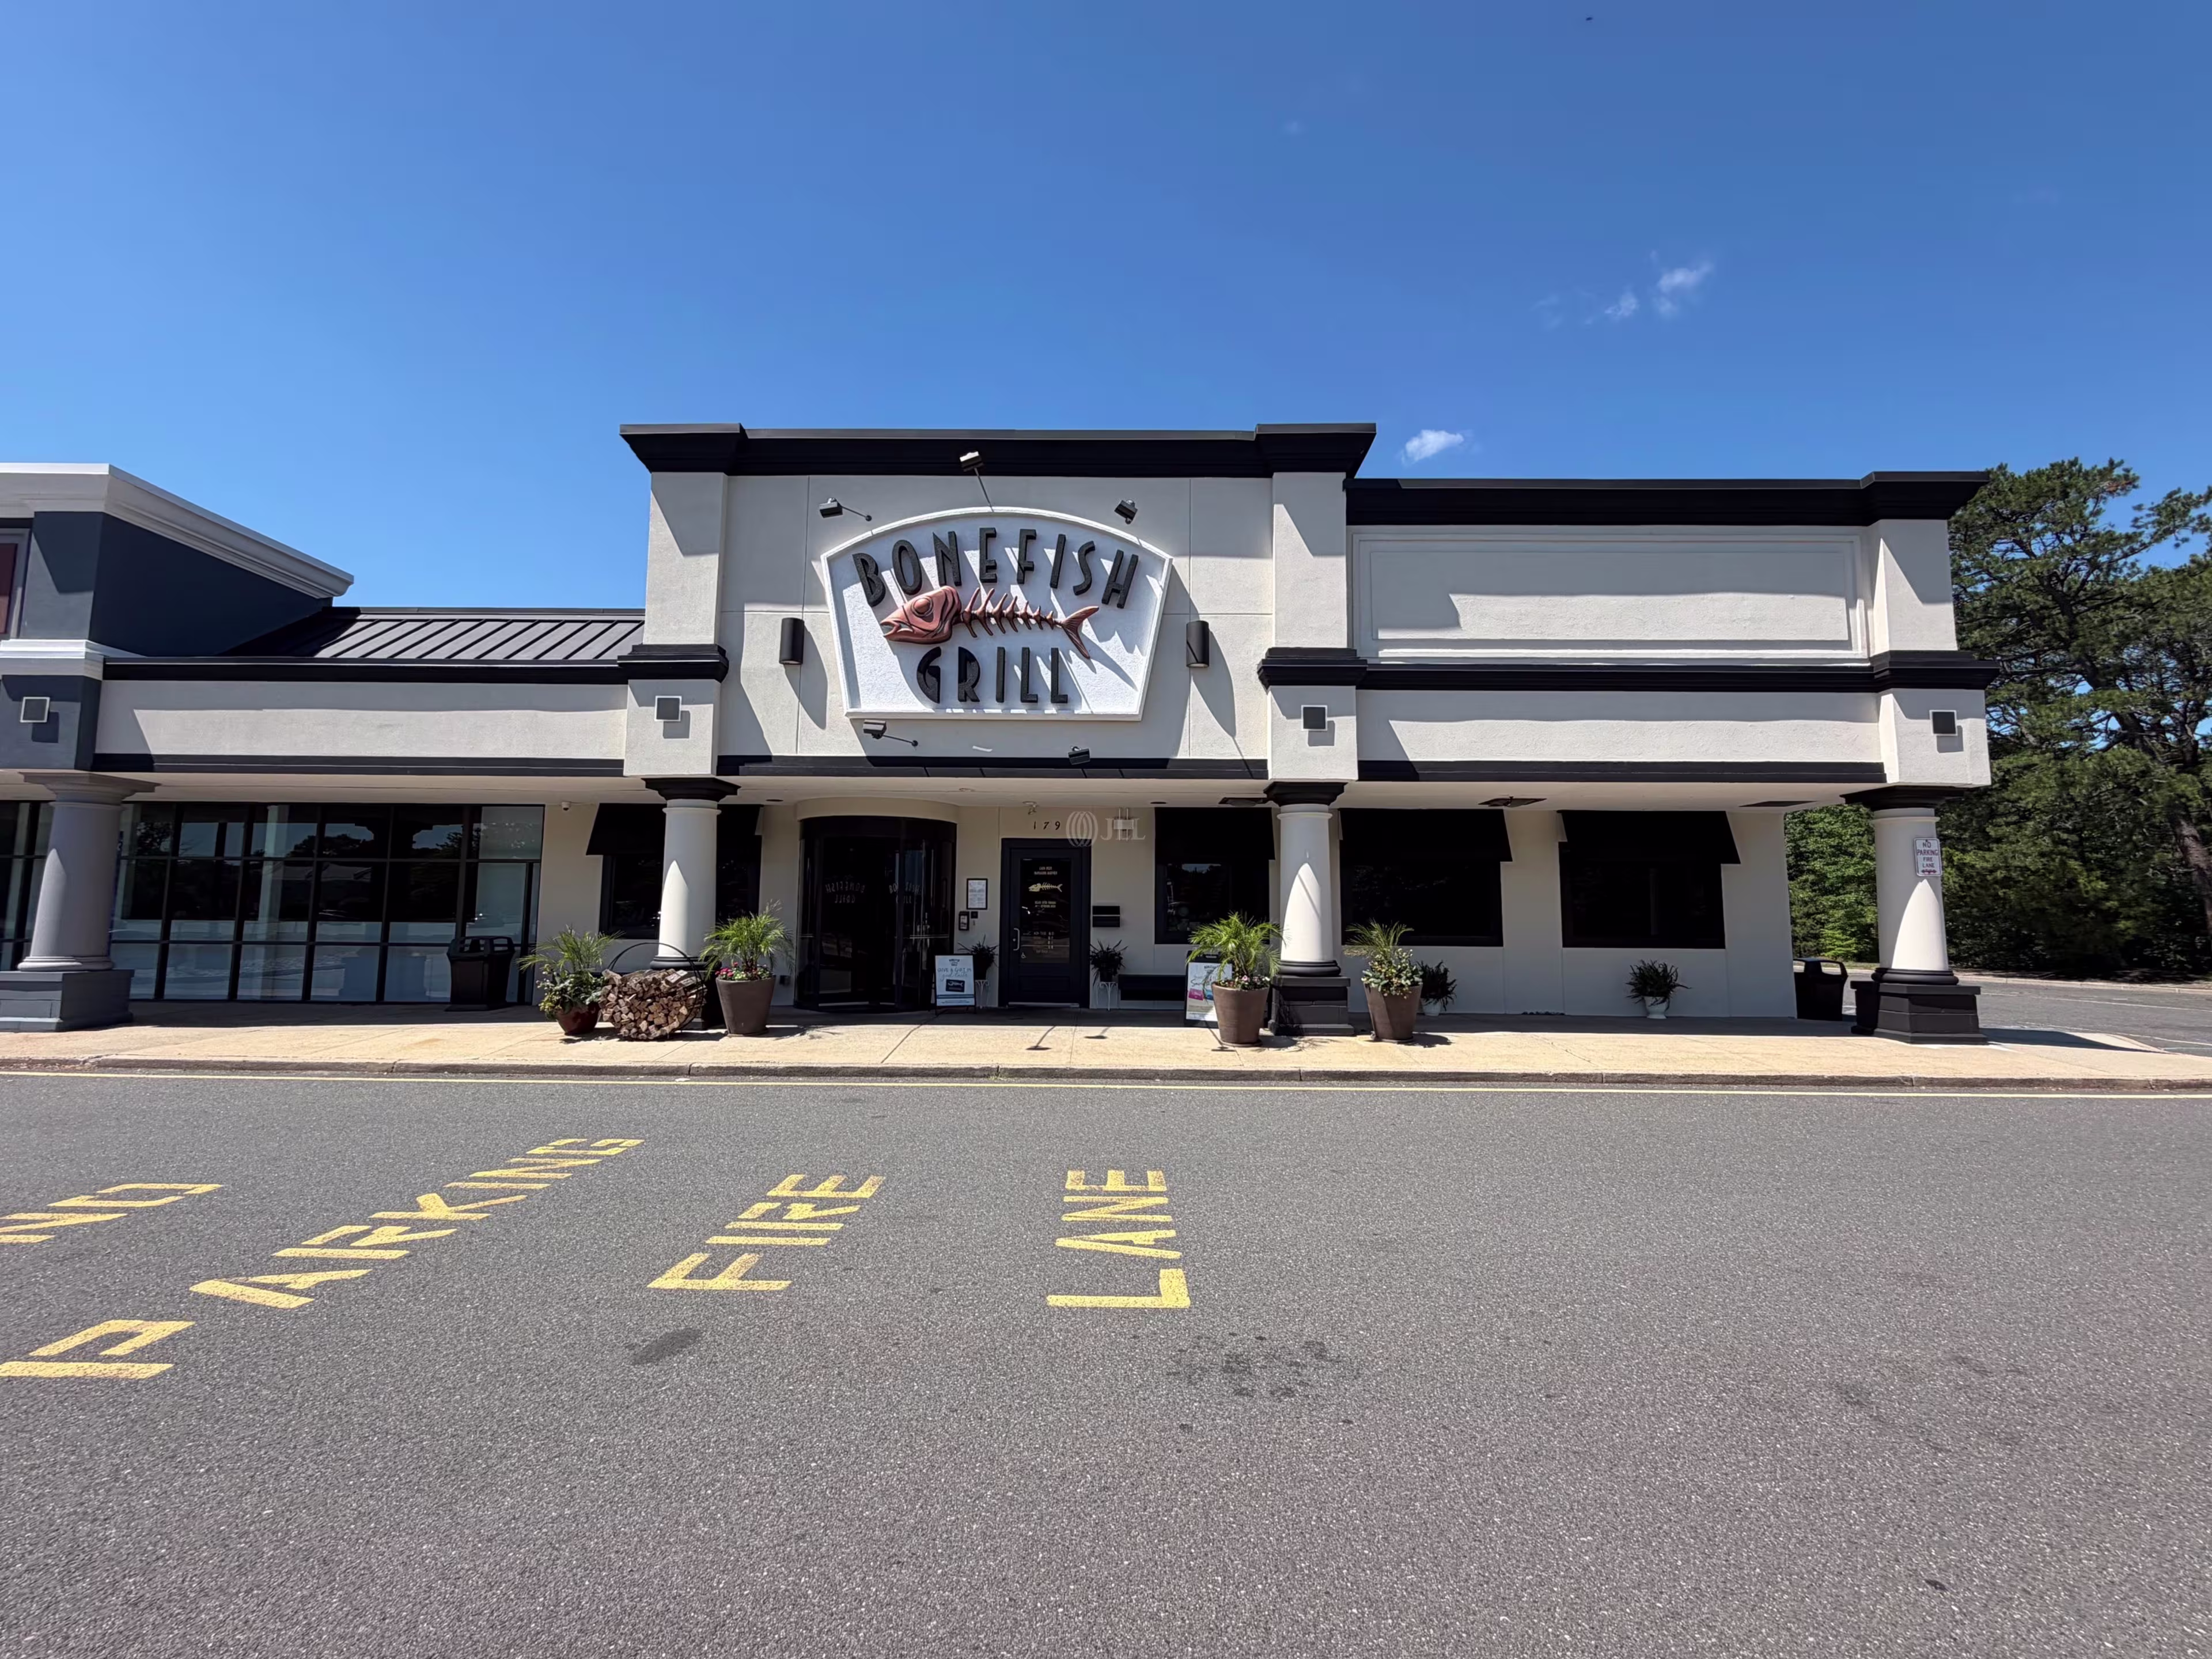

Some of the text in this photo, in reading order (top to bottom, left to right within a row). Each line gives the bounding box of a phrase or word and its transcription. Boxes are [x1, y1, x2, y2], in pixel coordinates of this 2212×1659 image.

[852, 527, 1139, 609] BONEFISH
[916, 646, 1069, 704] GRILL
[1033, 820, 1061, 831] 179
[0, 1183, 223, 1244] NO
[646, 1173, 886, 1291] FIRE
[1046, 1169, 1191, 1308] LANE
[0, 1138, 645, 1379] PARKING
